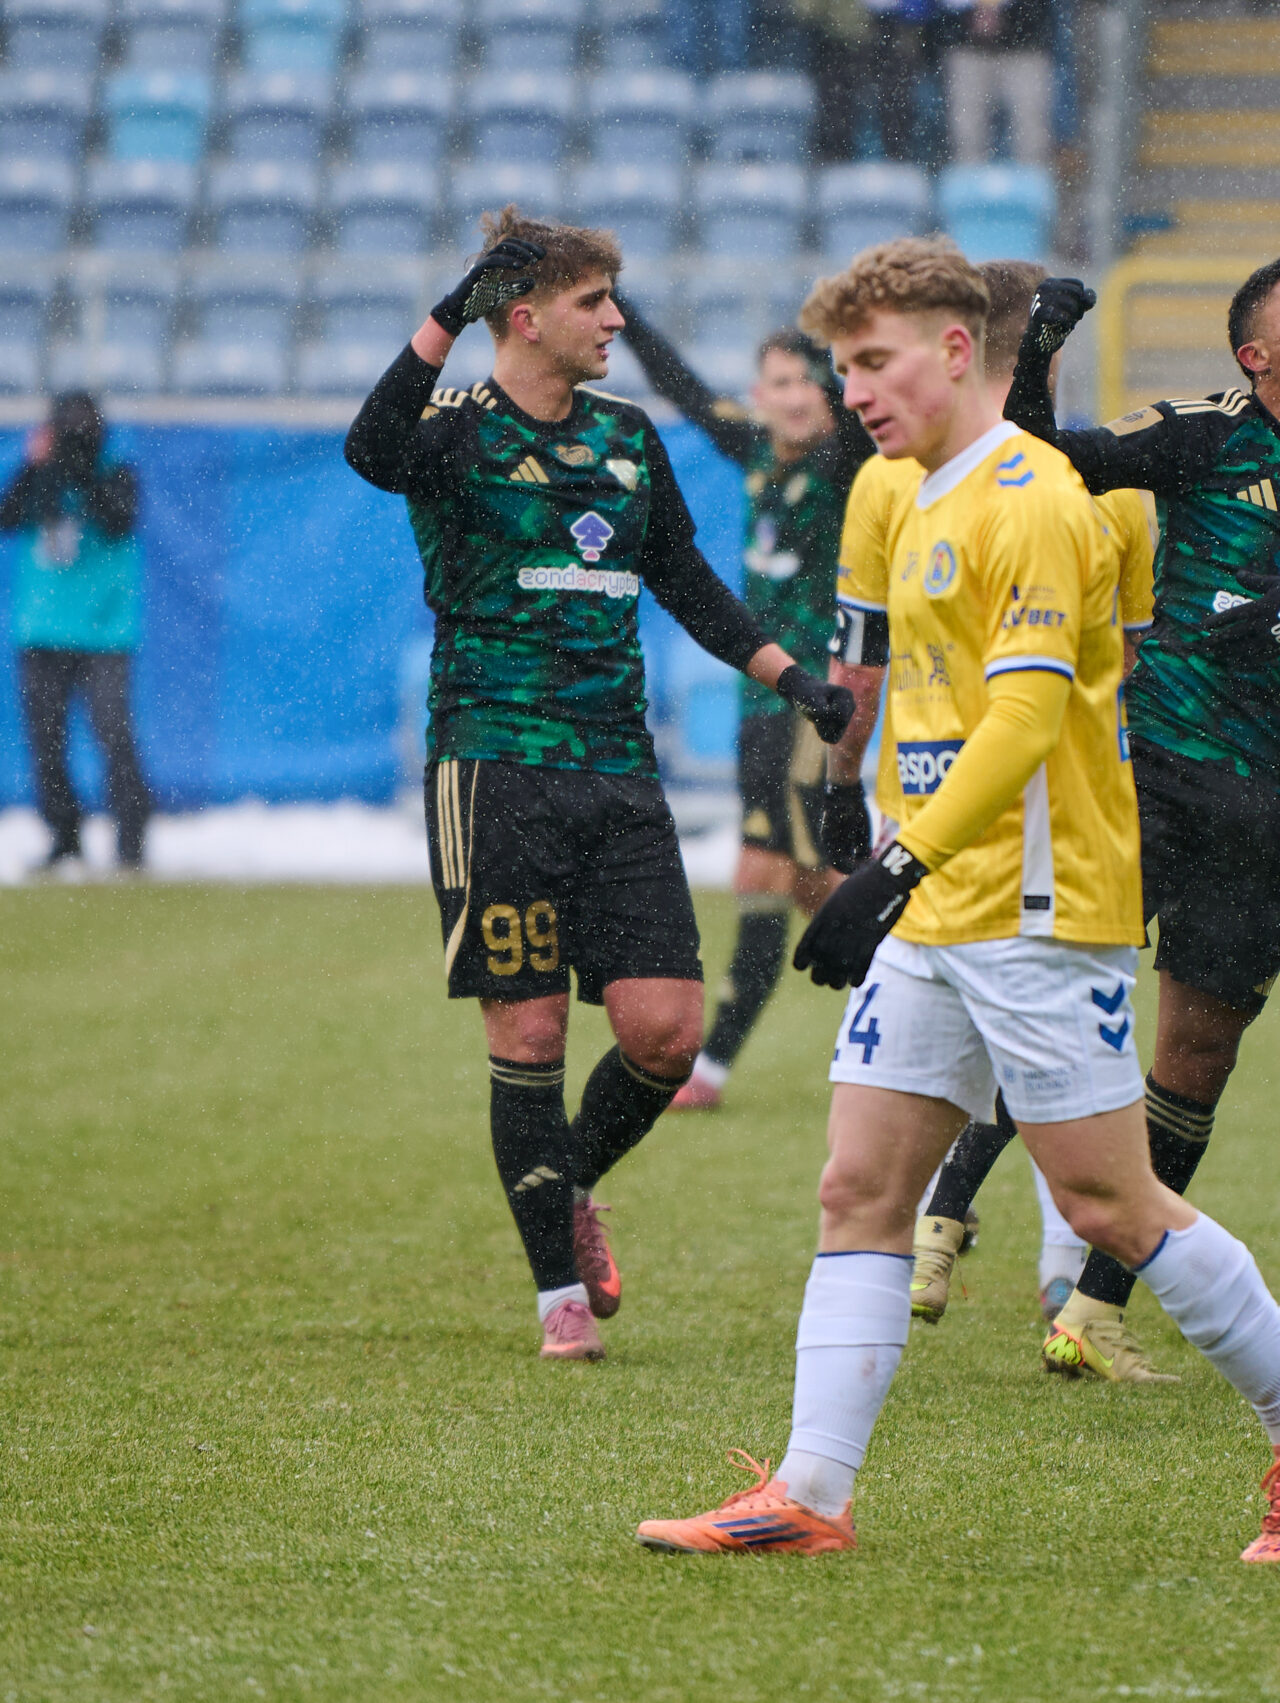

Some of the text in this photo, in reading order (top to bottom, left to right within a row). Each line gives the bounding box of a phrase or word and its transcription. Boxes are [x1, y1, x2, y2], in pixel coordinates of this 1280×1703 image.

[519, 564, 638, 598] zondacrypto
[481, 900, 560, 976] 99
[835, 982, 882, 1064] 4
